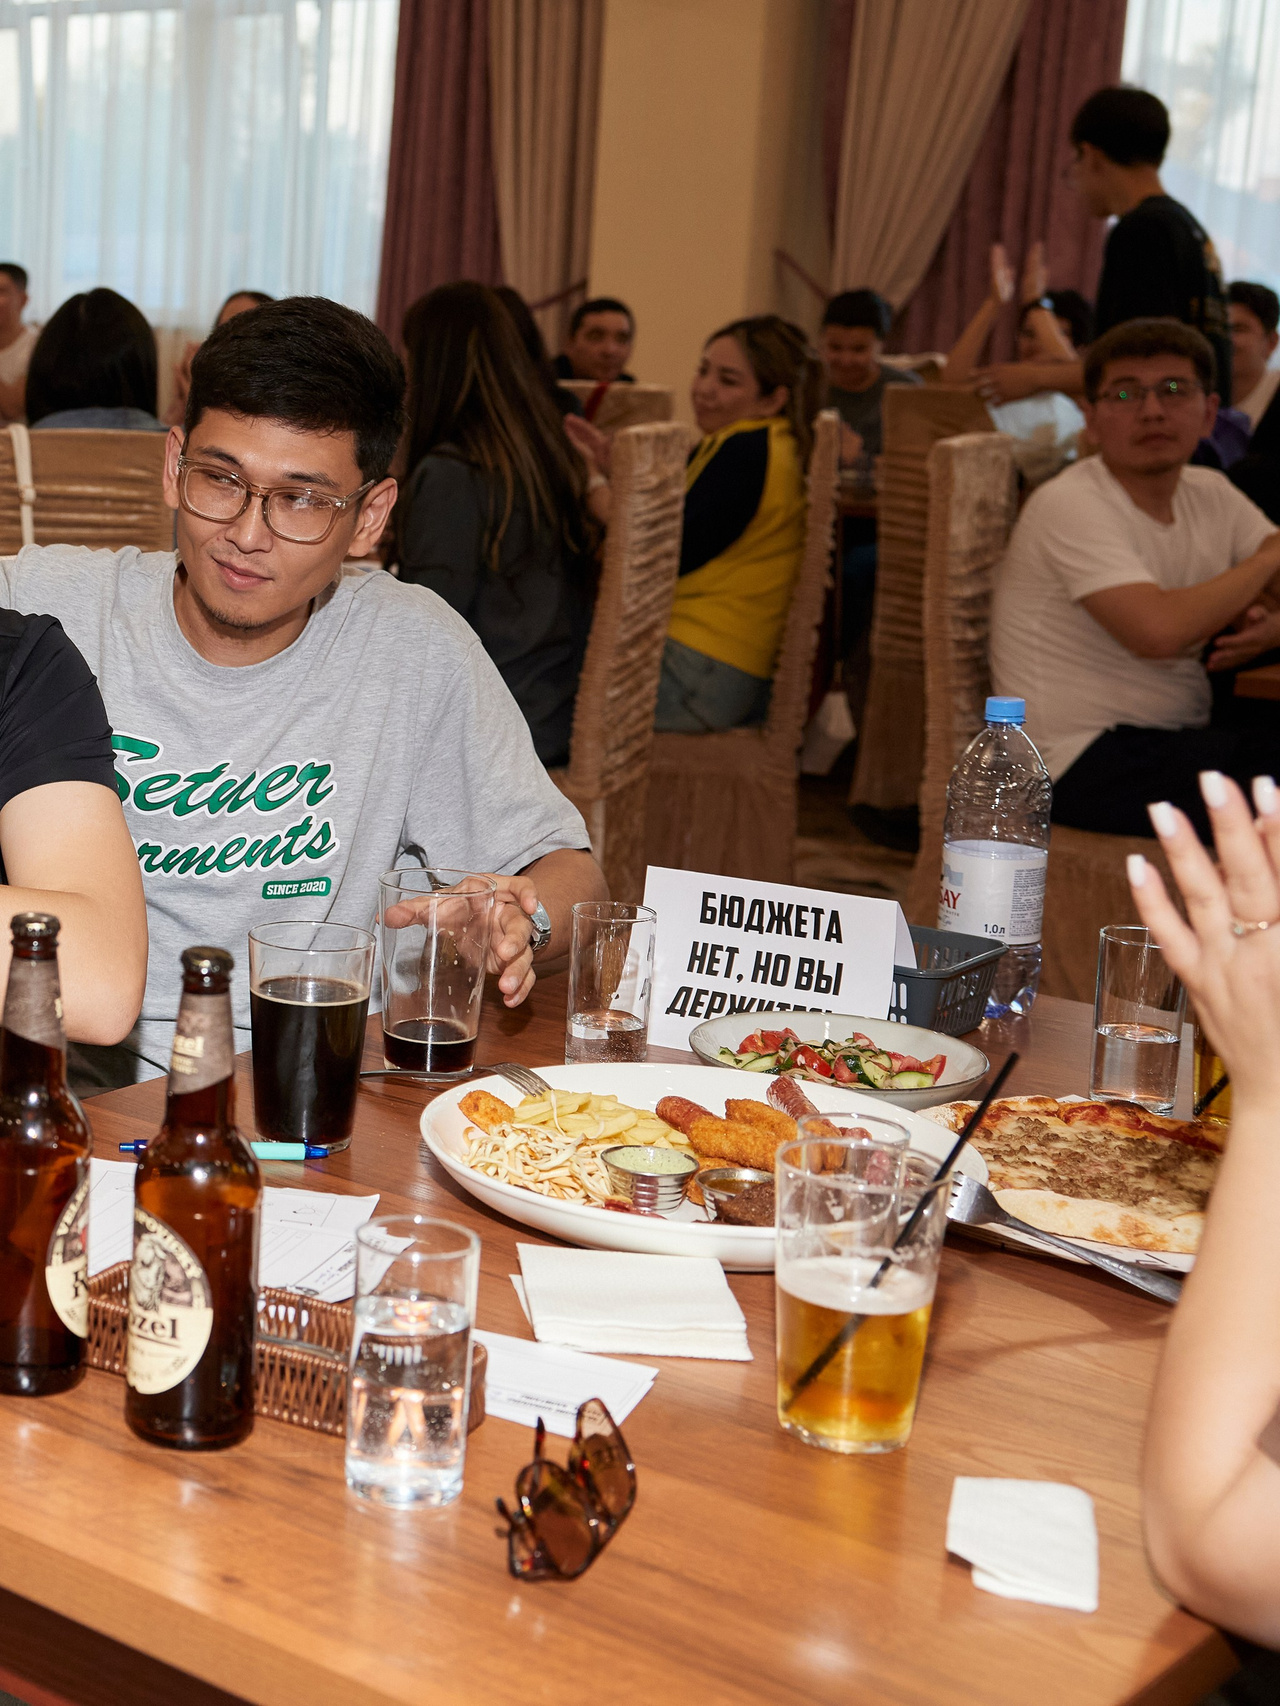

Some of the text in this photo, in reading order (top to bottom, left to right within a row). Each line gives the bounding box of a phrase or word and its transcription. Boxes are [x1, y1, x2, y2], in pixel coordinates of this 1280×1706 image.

[136, 815, 337, 876] rments
[266, 880, 326, 896] SINCE 2020
[699, 890, 843, 944] БЮДЖЕТА
[686, 941, 844, 996] НЕТ, НО ВЫ
